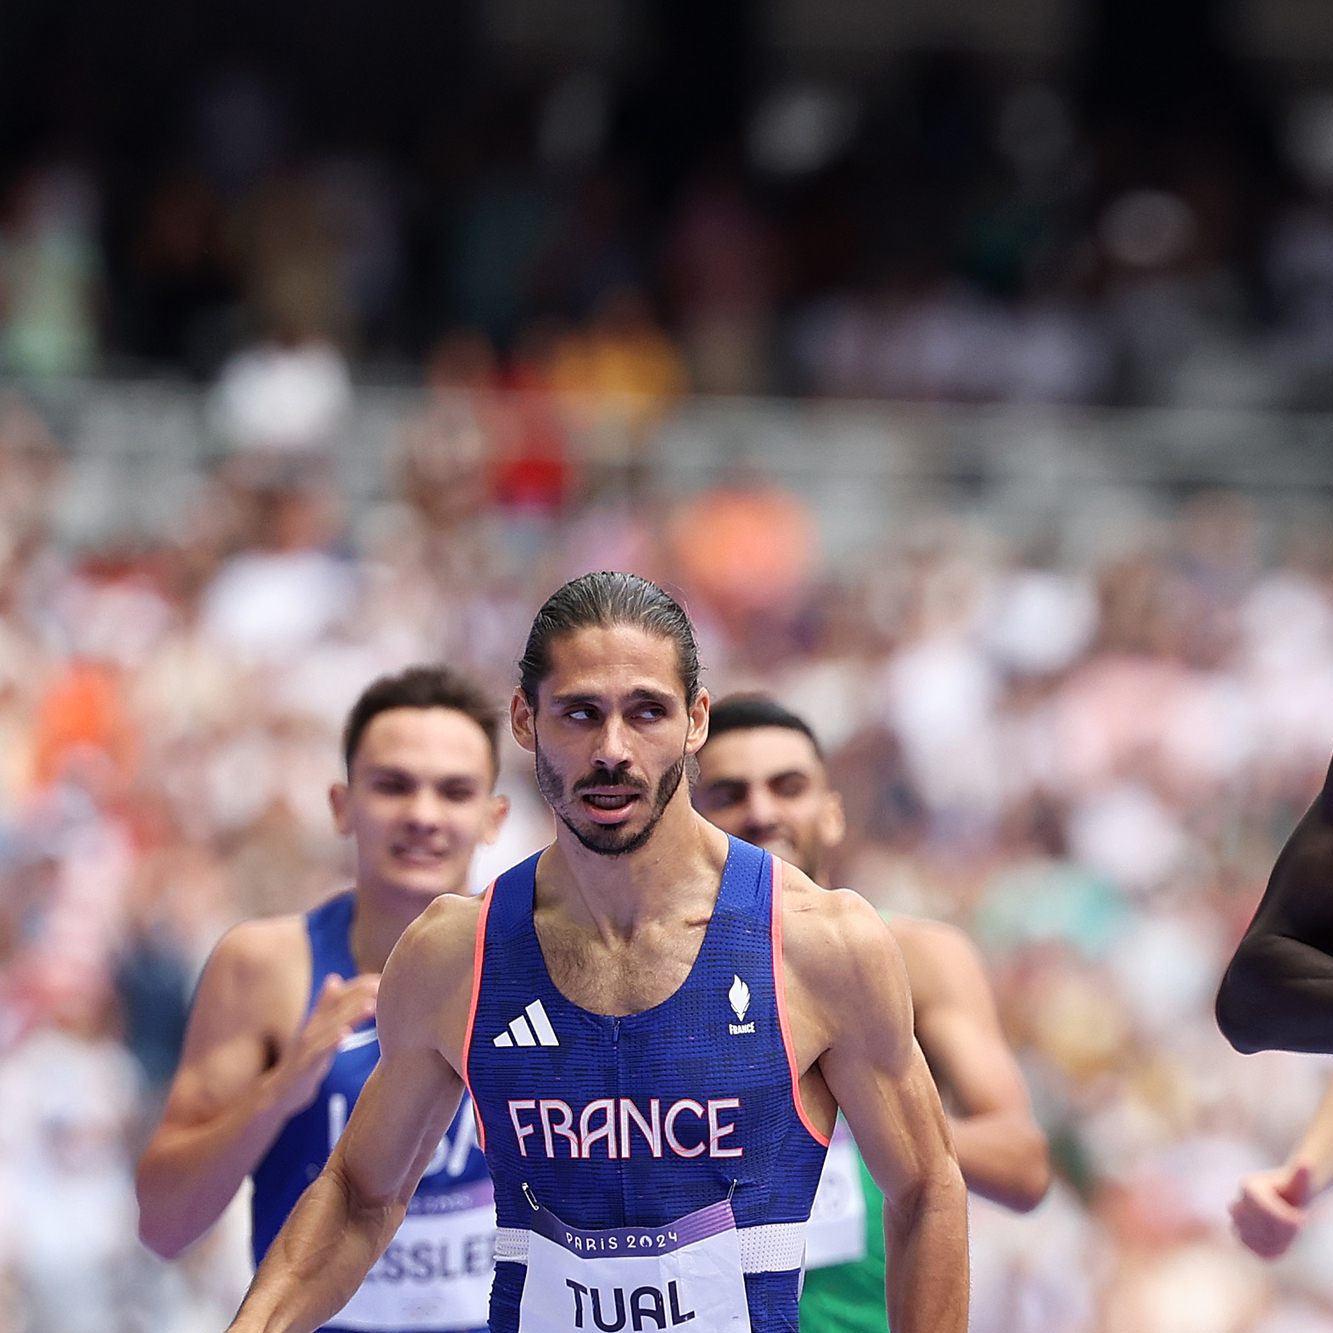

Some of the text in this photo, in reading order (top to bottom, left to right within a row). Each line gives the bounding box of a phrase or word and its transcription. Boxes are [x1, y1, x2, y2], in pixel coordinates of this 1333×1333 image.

[728, 1020, 756, 1034] FRANCE
[507, 1098, 743, 1159] FRANCE
[566, 1230, 680, 1251] PARIS 2024
[565, 1278, 696, 1333] TUAL
